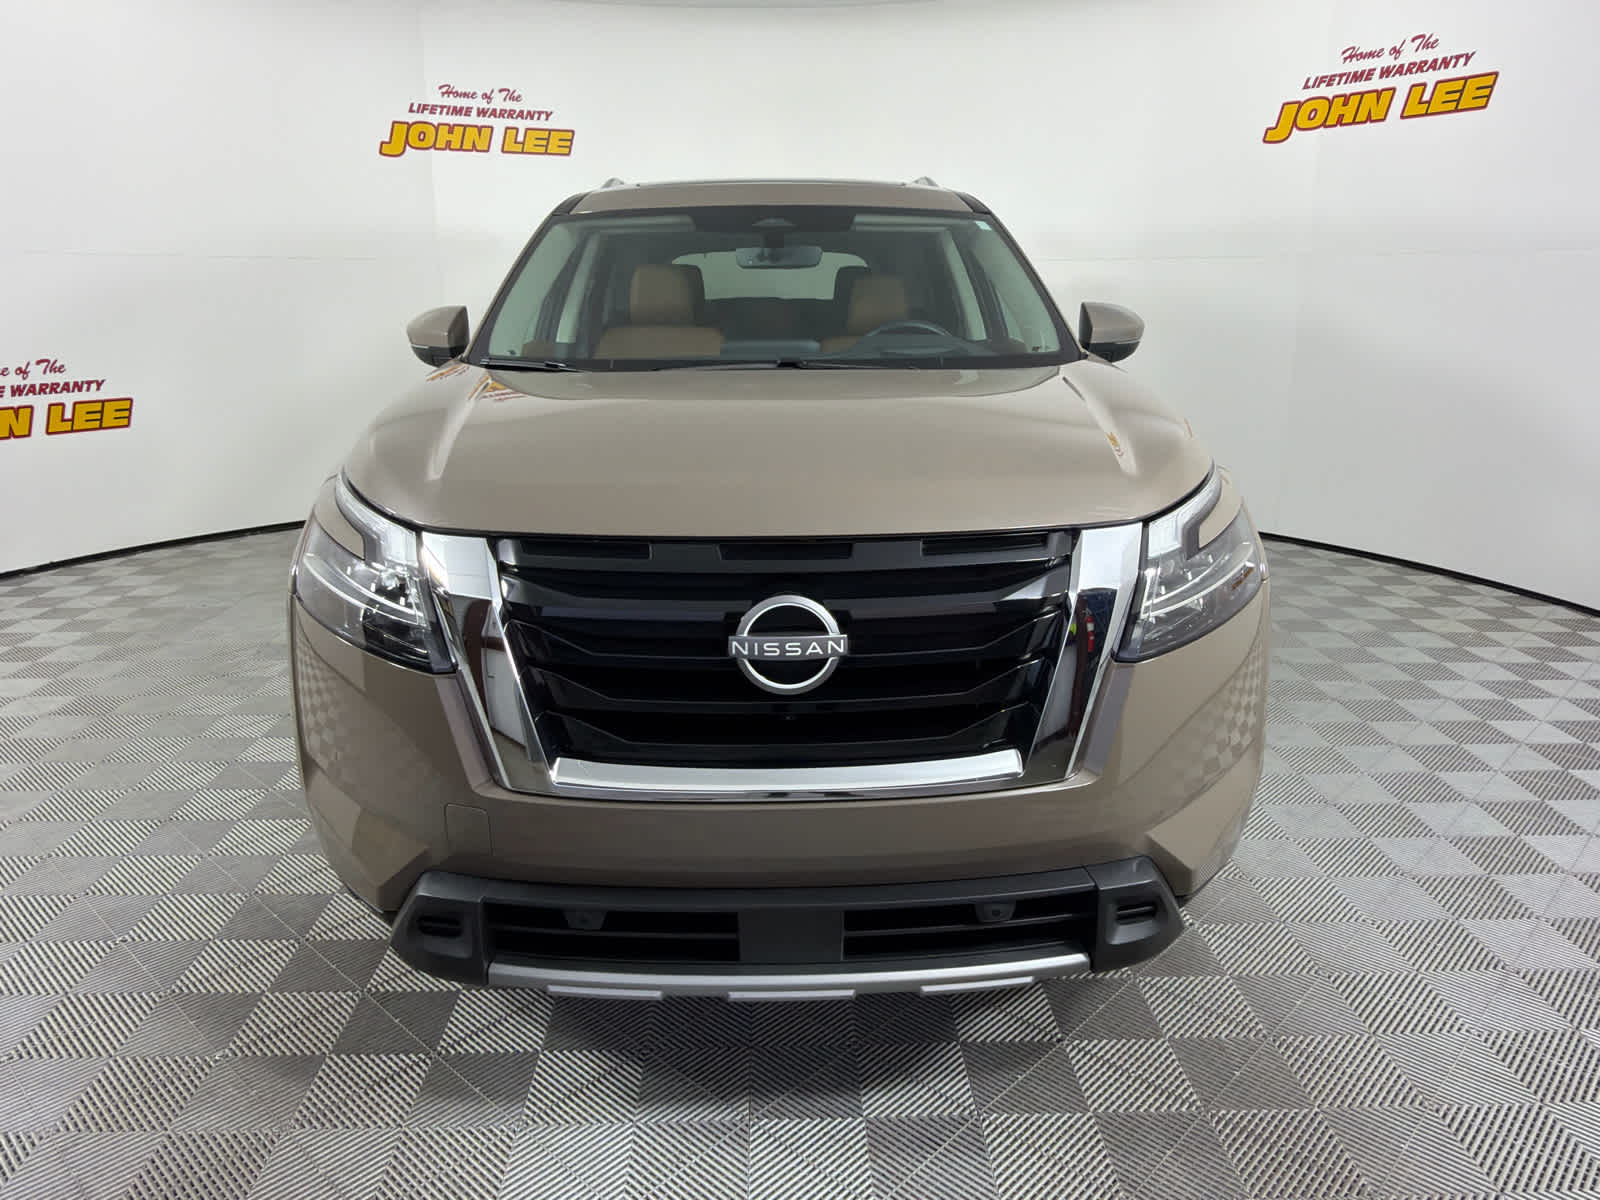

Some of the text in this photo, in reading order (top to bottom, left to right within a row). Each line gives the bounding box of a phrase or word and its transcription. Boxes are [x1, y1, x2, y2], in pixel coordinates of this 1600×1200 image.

[1341, 33, 1439, 64] Home of The
[1303, 51, 1476, 90] LIFETIME WARRANTY
[438, 84, 522, 104] Home of The
[408, 102, 553, 121] LIFETIME WARRANTY
[1263, 71, 1499, 144] JOHN LEE
[379, 120, 575, 157] JOHN LEE
[15, 361, 30, 380] of
[35, 359, 66, 375] The
[10, 379, 106, 397] WARRANTY
[46, 398, 133, 435] LEE
[732, 640, 844, 656] NISSAN
